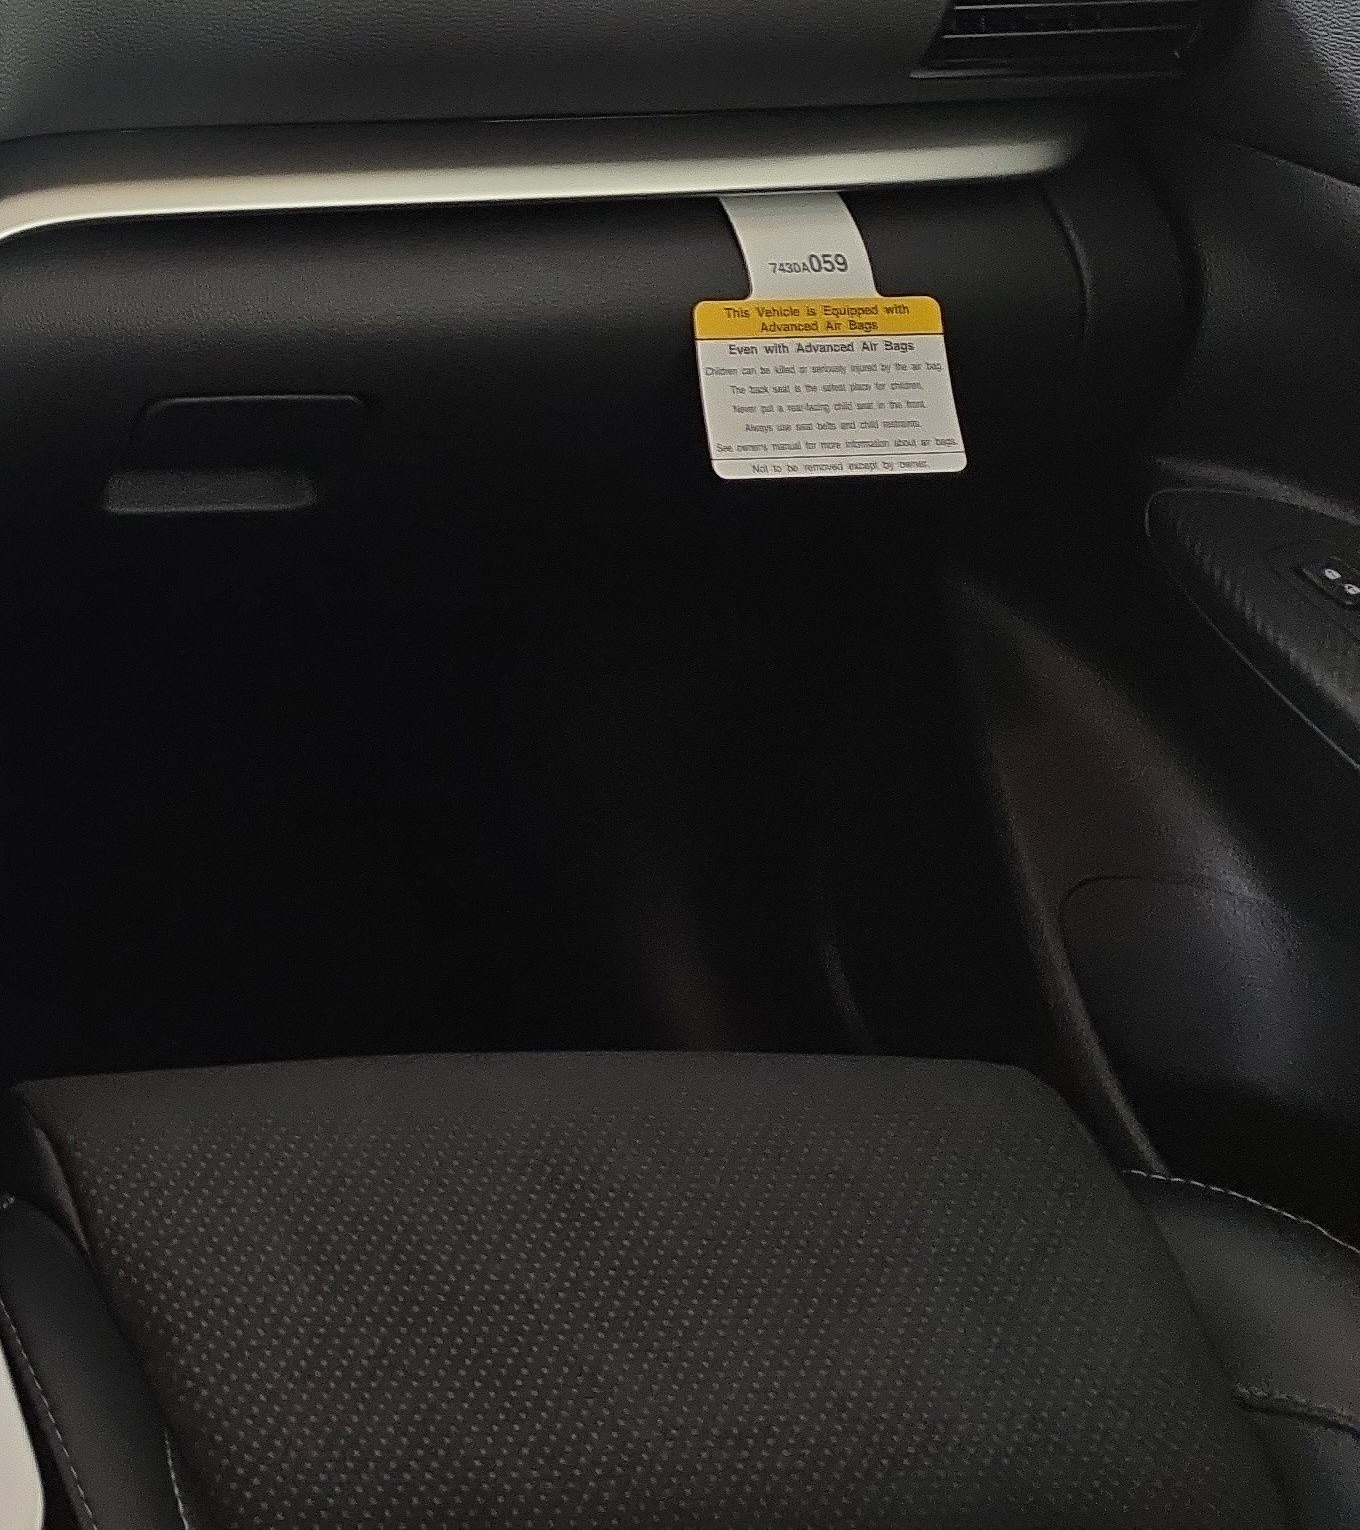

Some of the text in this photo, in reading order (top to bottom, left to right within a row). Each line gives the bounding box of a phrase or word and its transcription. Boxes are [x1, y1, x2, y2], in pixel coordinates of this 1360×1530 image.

[724, 304, 910, 319] This Vehicle is Equipped with
[760, 319, 879, 333] Advanced Air Bags
[728, 340, 916, 355] Even with Advanced Air Bags
